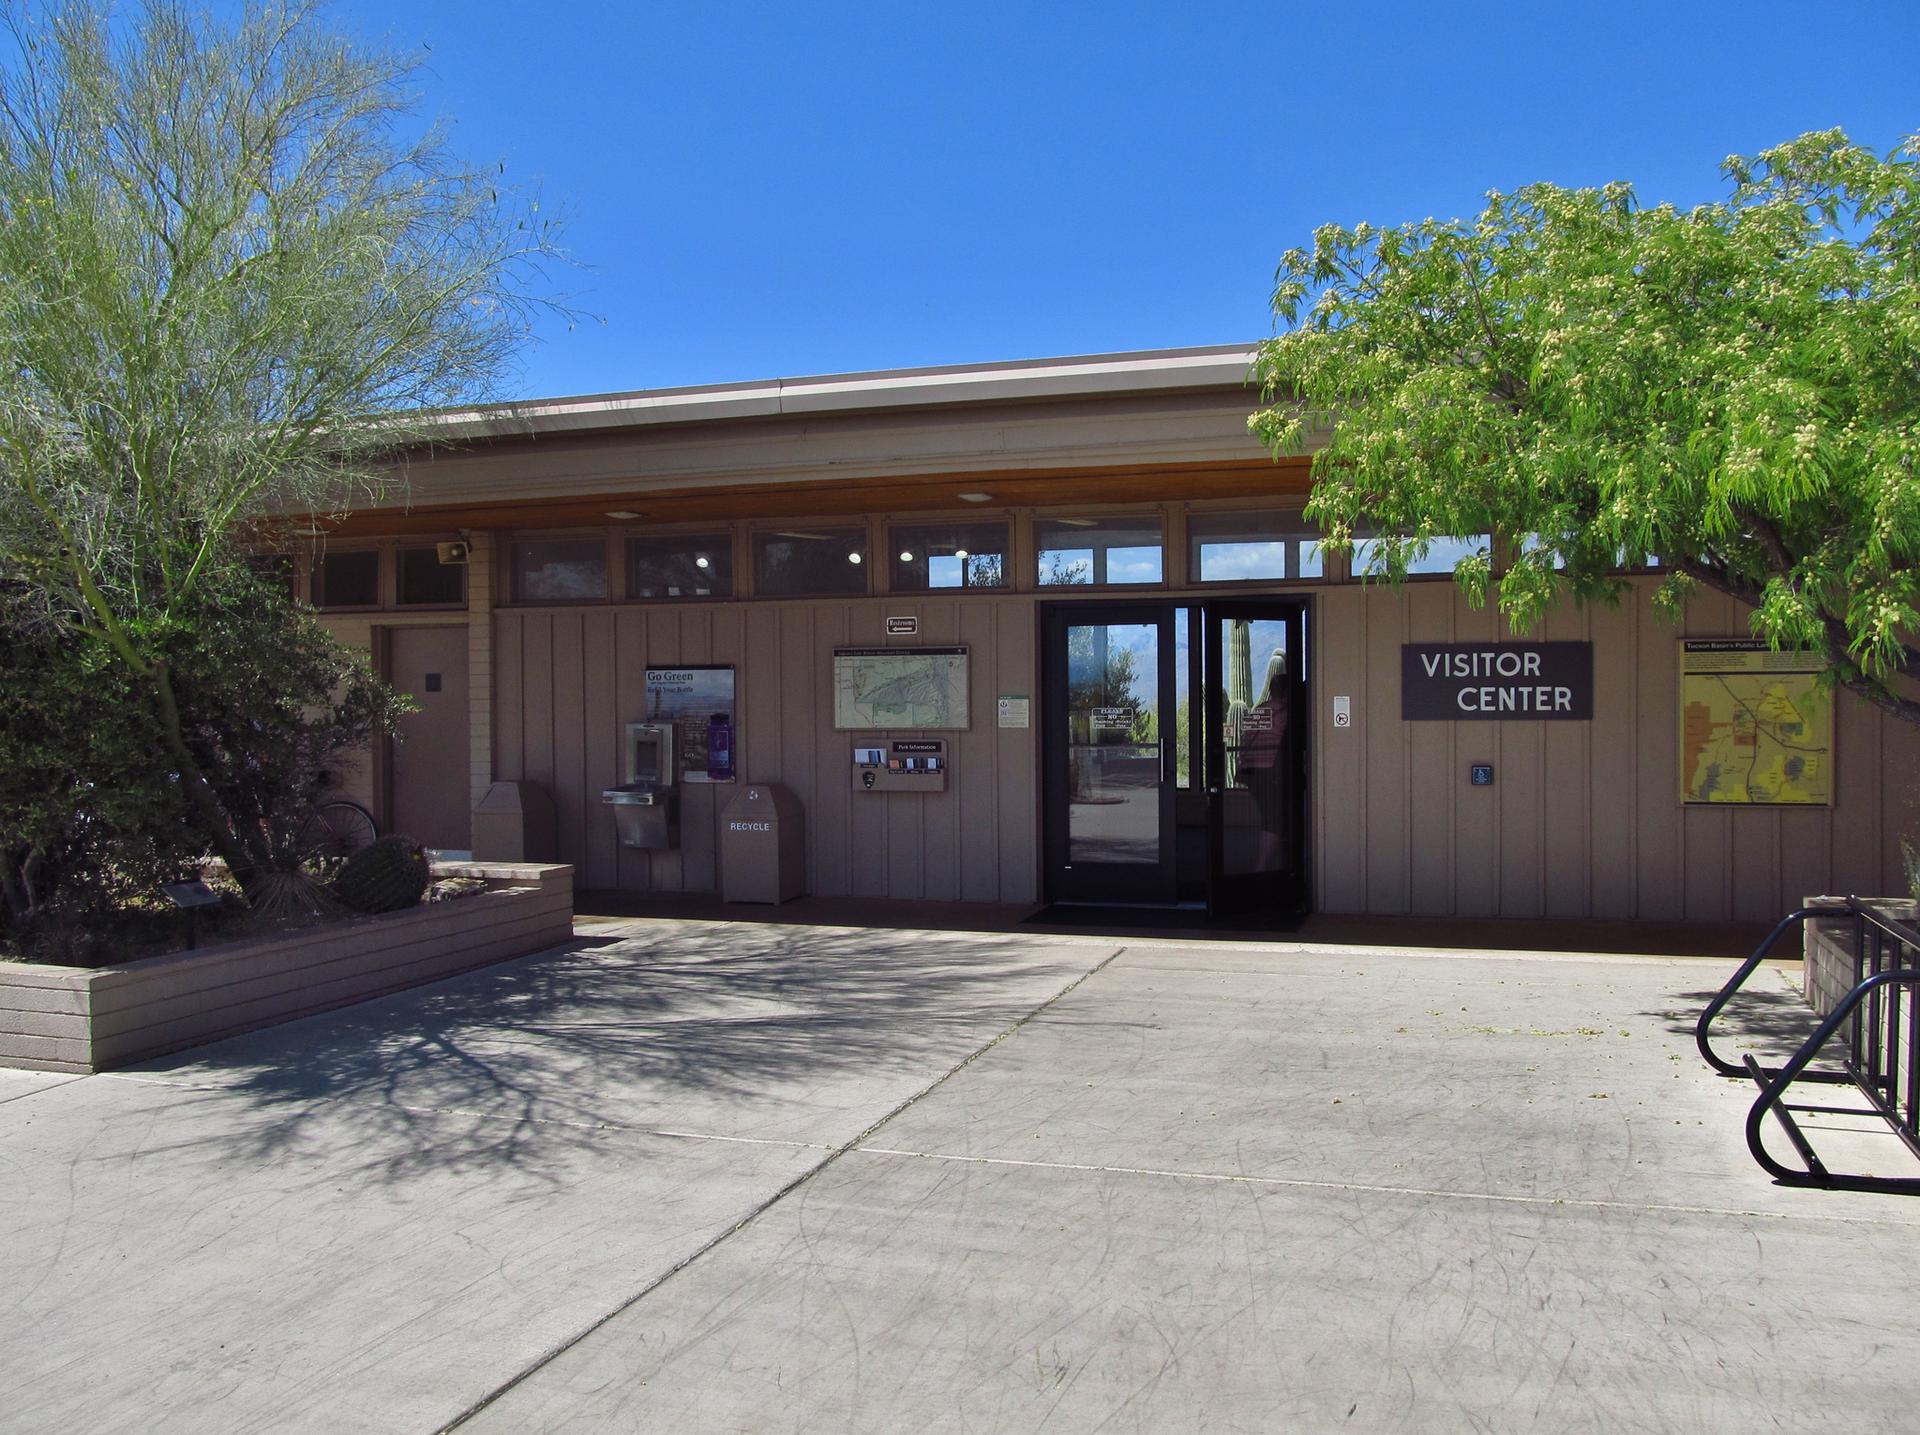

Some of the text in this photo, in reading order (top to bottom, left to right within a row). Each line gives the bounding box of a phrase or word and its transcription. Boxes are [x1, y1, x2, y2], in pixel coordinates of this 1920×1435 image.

[1420, 652, 1541, 677] VISITOR
[647, 671, 694, 681] Go Green
[1457, 686, 1572, 711] CENTER
[730, 822, 770, 831] RECYCLE
